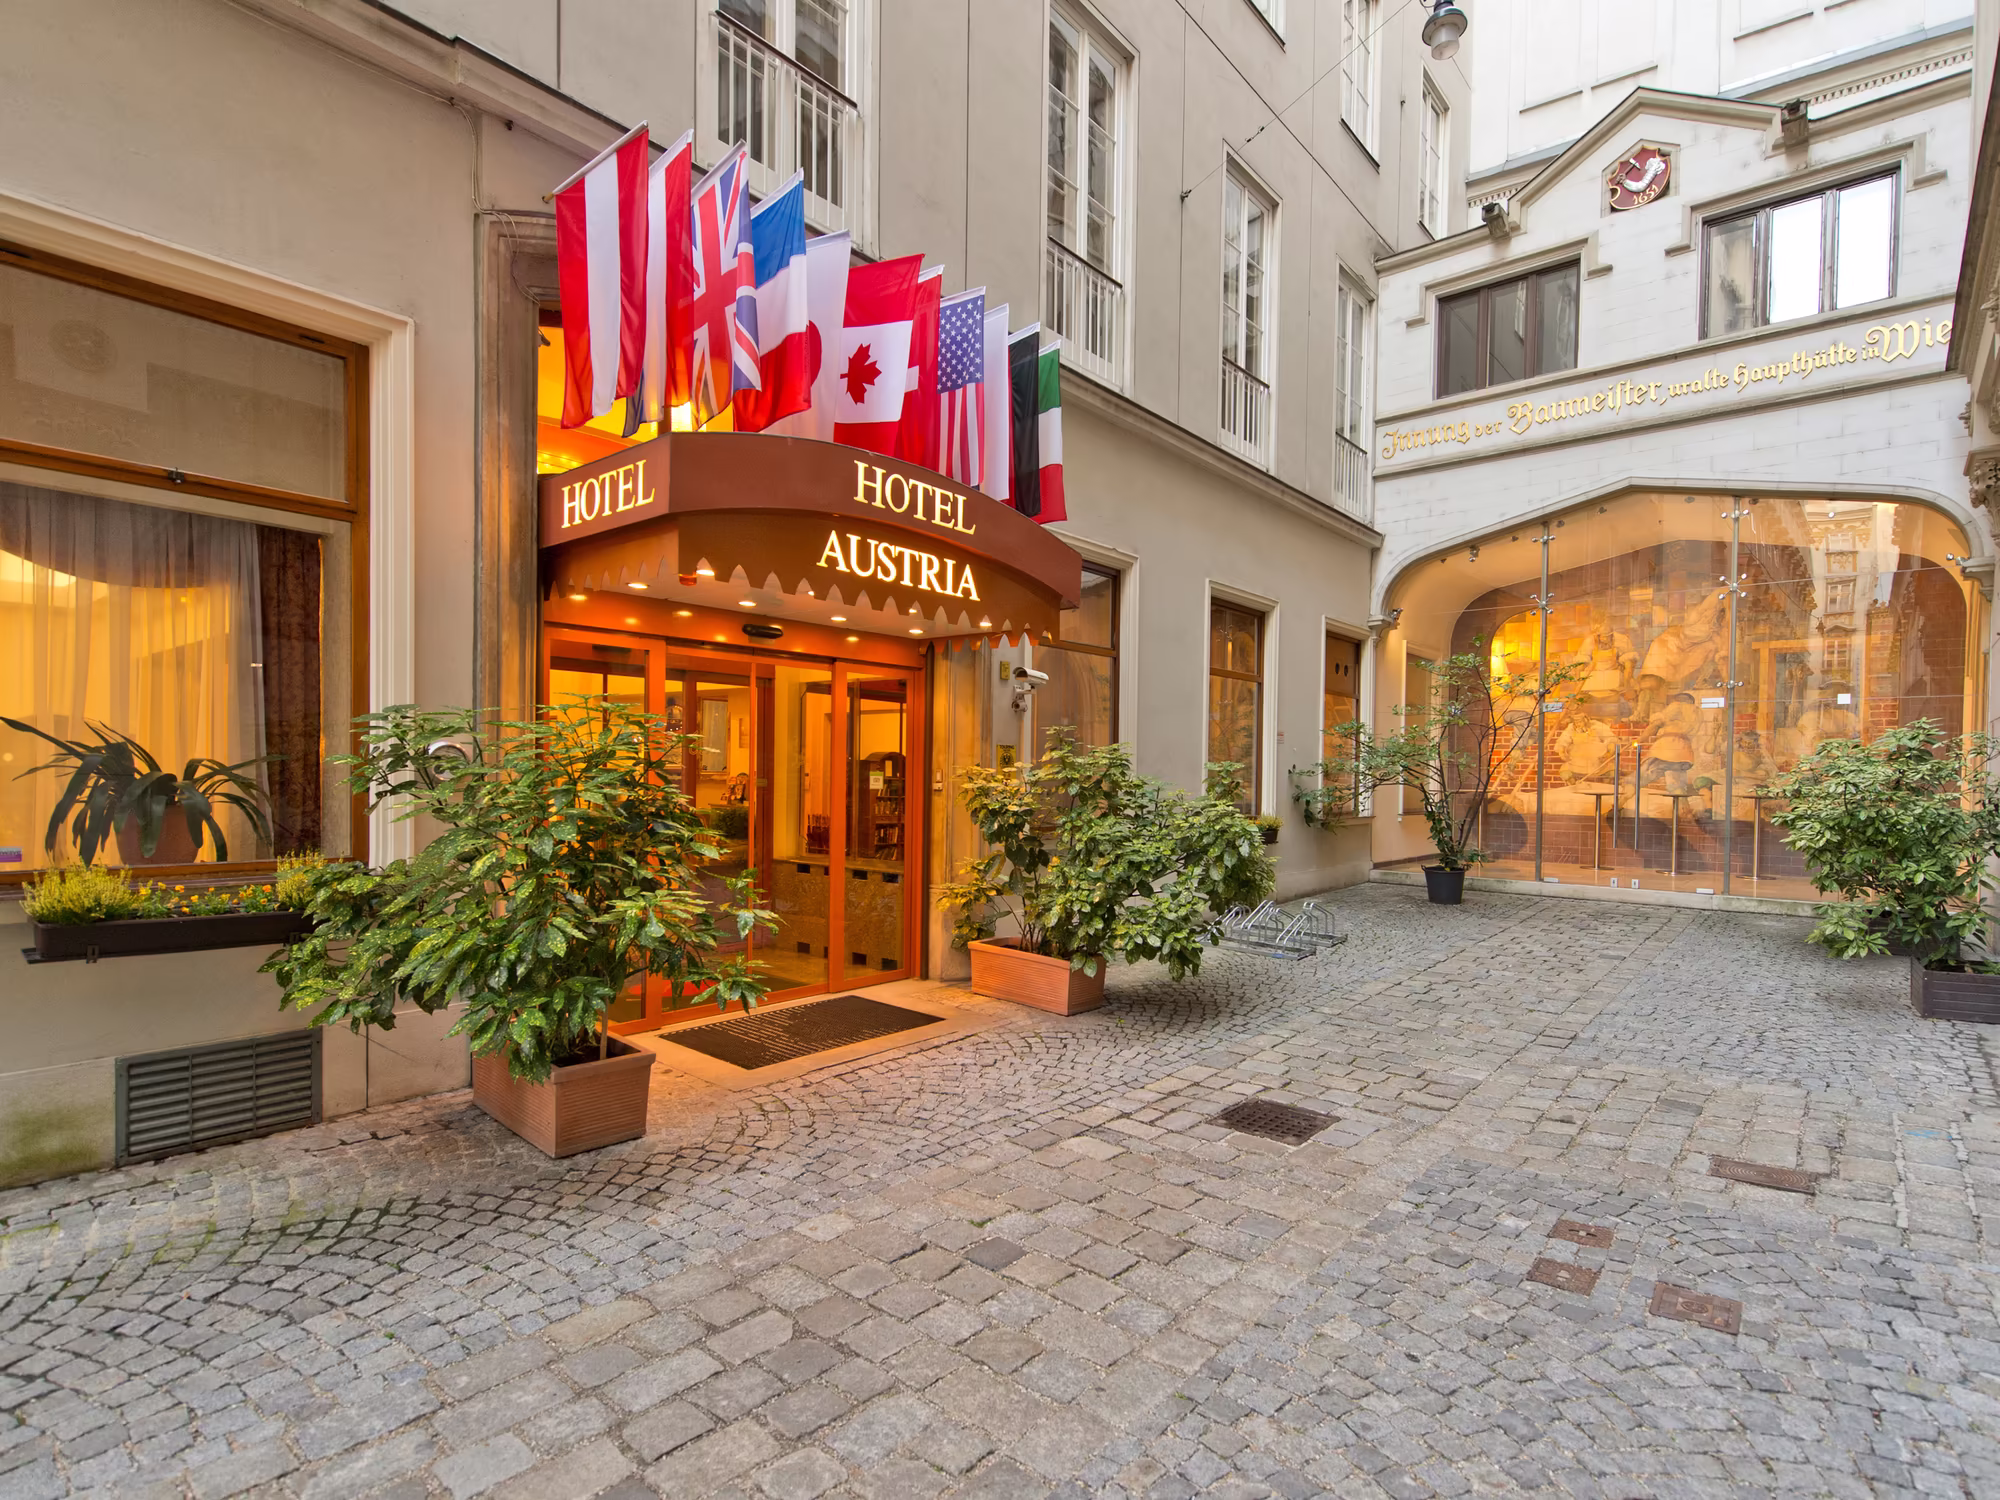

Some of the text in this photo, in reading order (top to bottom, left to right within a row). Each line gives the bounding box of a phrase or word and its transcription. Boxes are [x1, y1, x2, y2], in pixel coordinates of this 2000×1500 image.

[1474, 420, 1503, 438] der
[1667, 368, 1730, 399] uralte
[1733, 341, 1857, 393] Haupthütte
[1861, 344, 1881, 361] in
[561, 458, 656, 529] HOTEL
[853, 459, 977, 536] HOTEL
[816, 529, 982, 602] AUSTRIA
